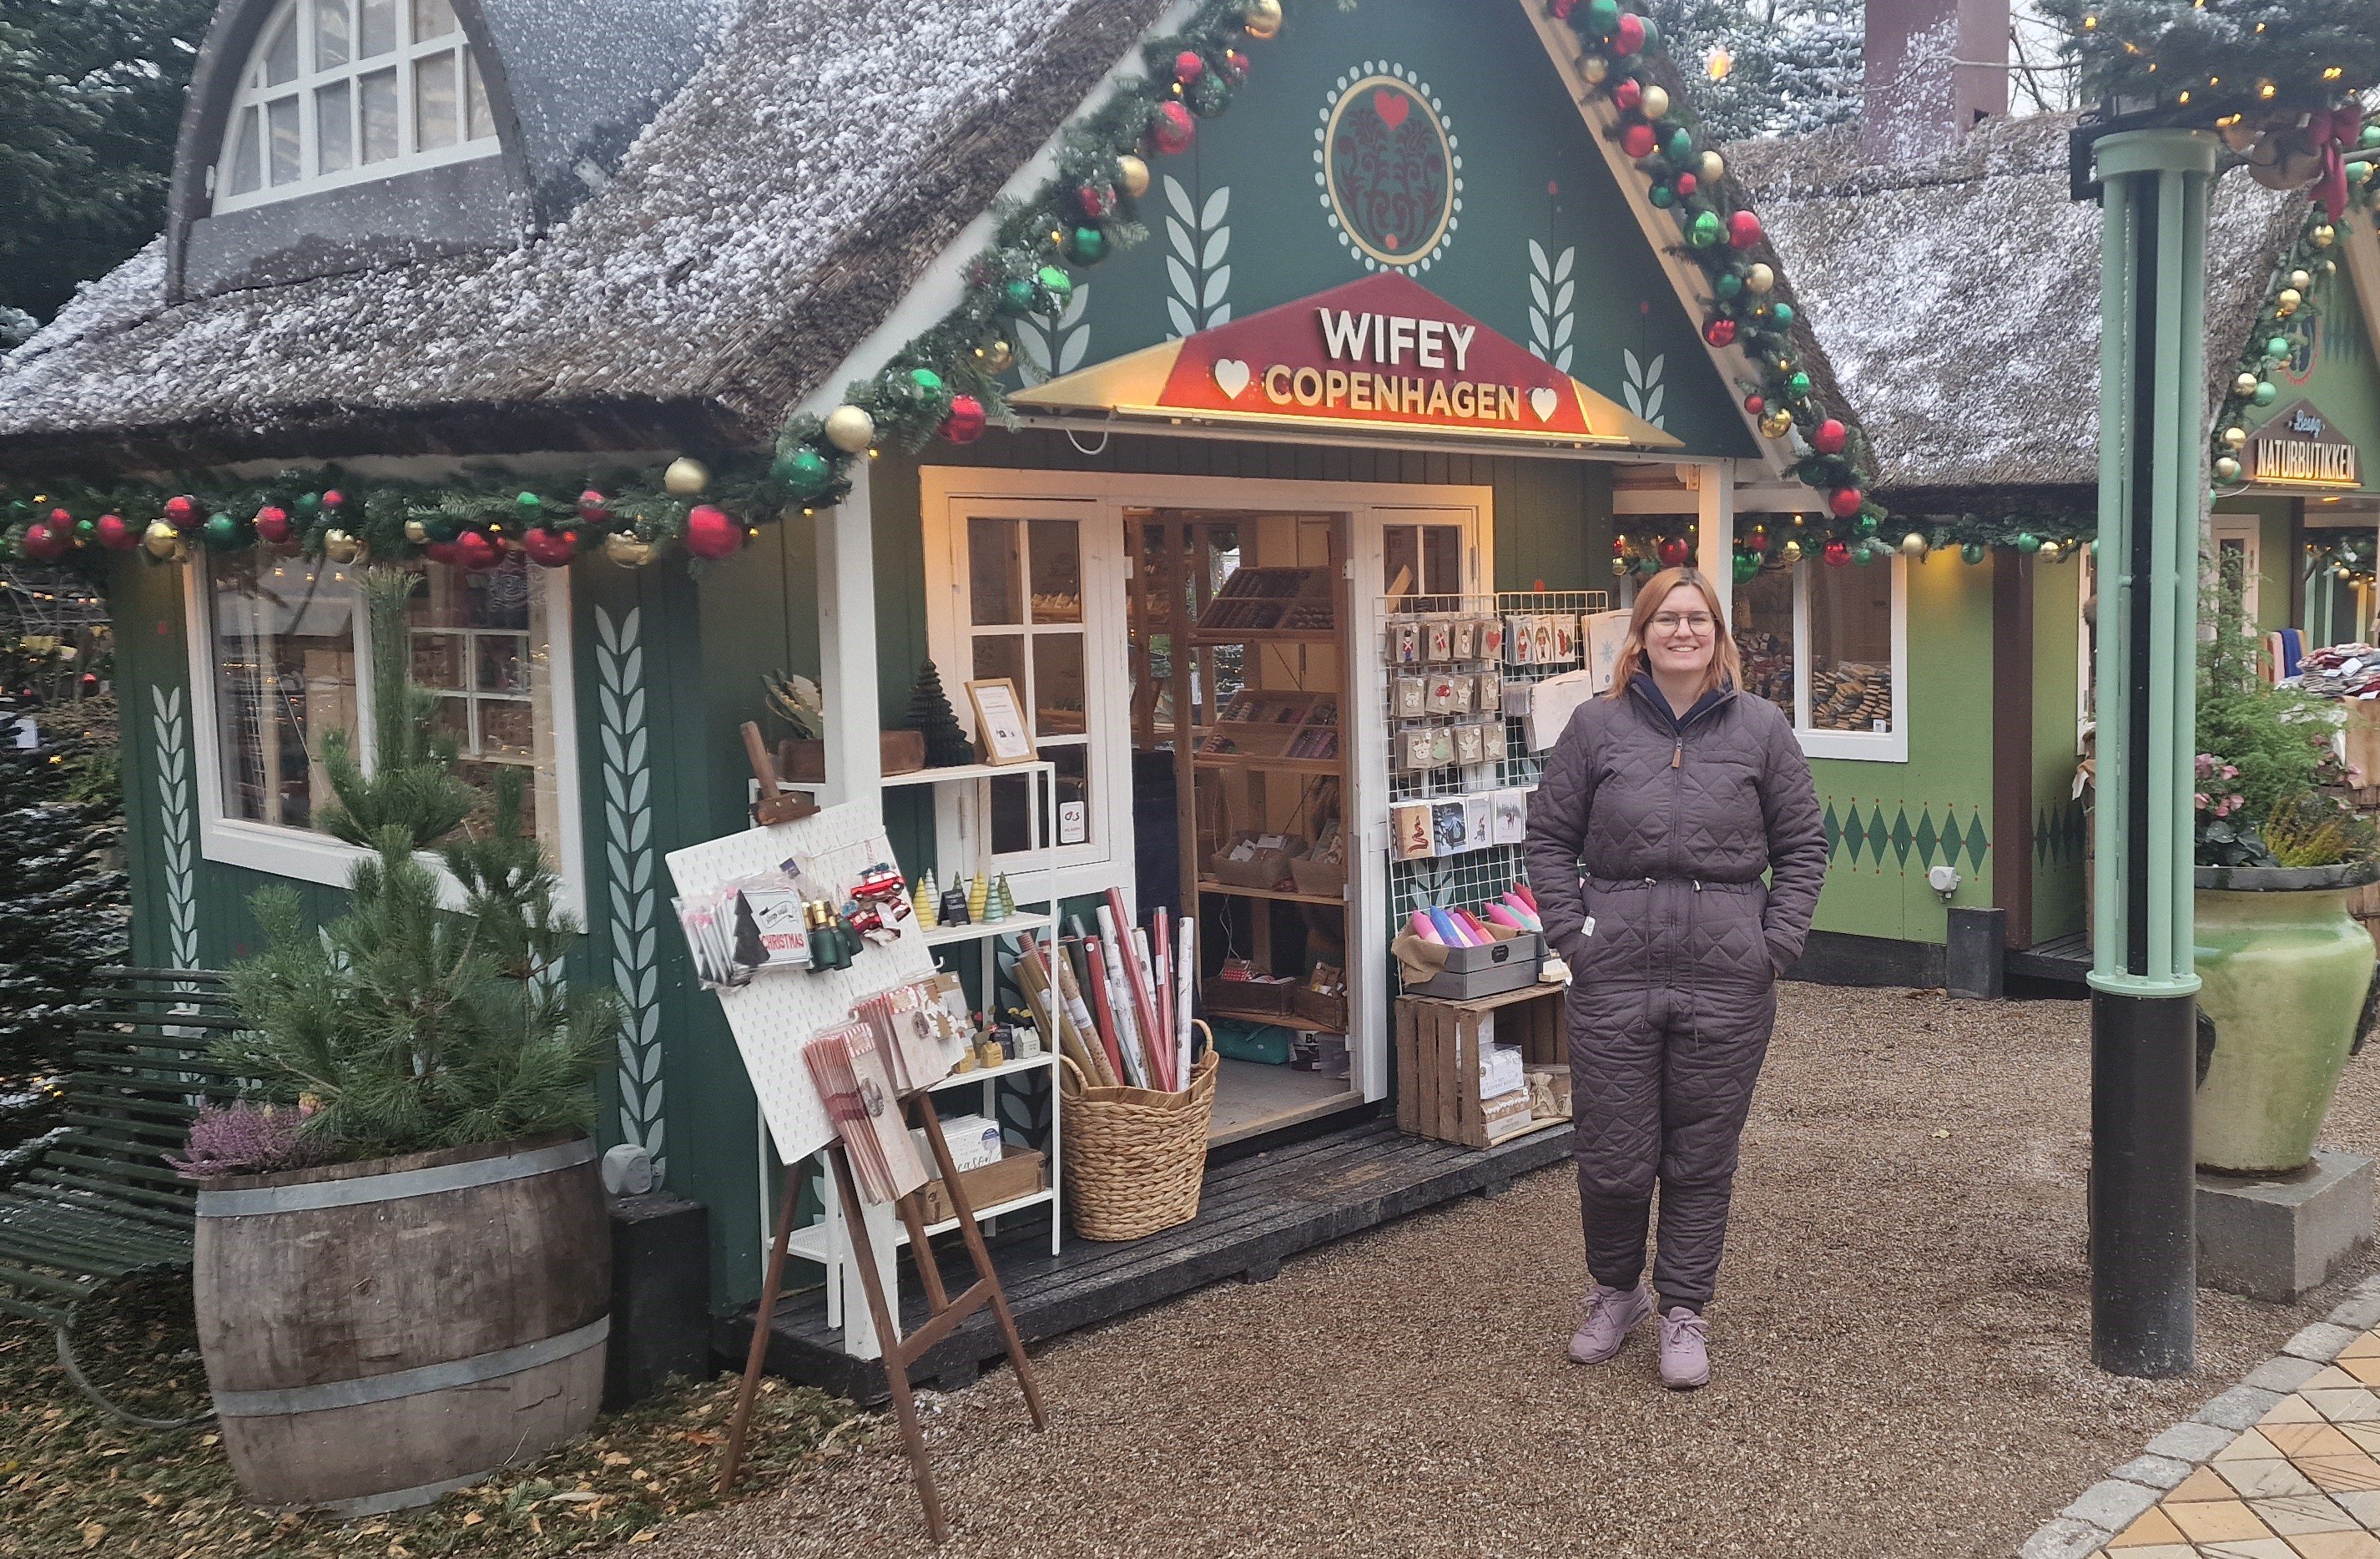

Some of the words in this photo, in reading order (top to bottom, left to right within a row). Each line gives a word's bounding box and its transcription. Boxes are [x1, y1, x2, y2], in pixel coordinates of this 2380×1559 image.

[1319, 307, 1476, 371] WIFEY
[1265, 364, 1520, 421] COPENHAGEN
[2256, 437, 2356, 480] NATURBUTIKKEN
[760, 932, 804, 951] CHRISTMAS
